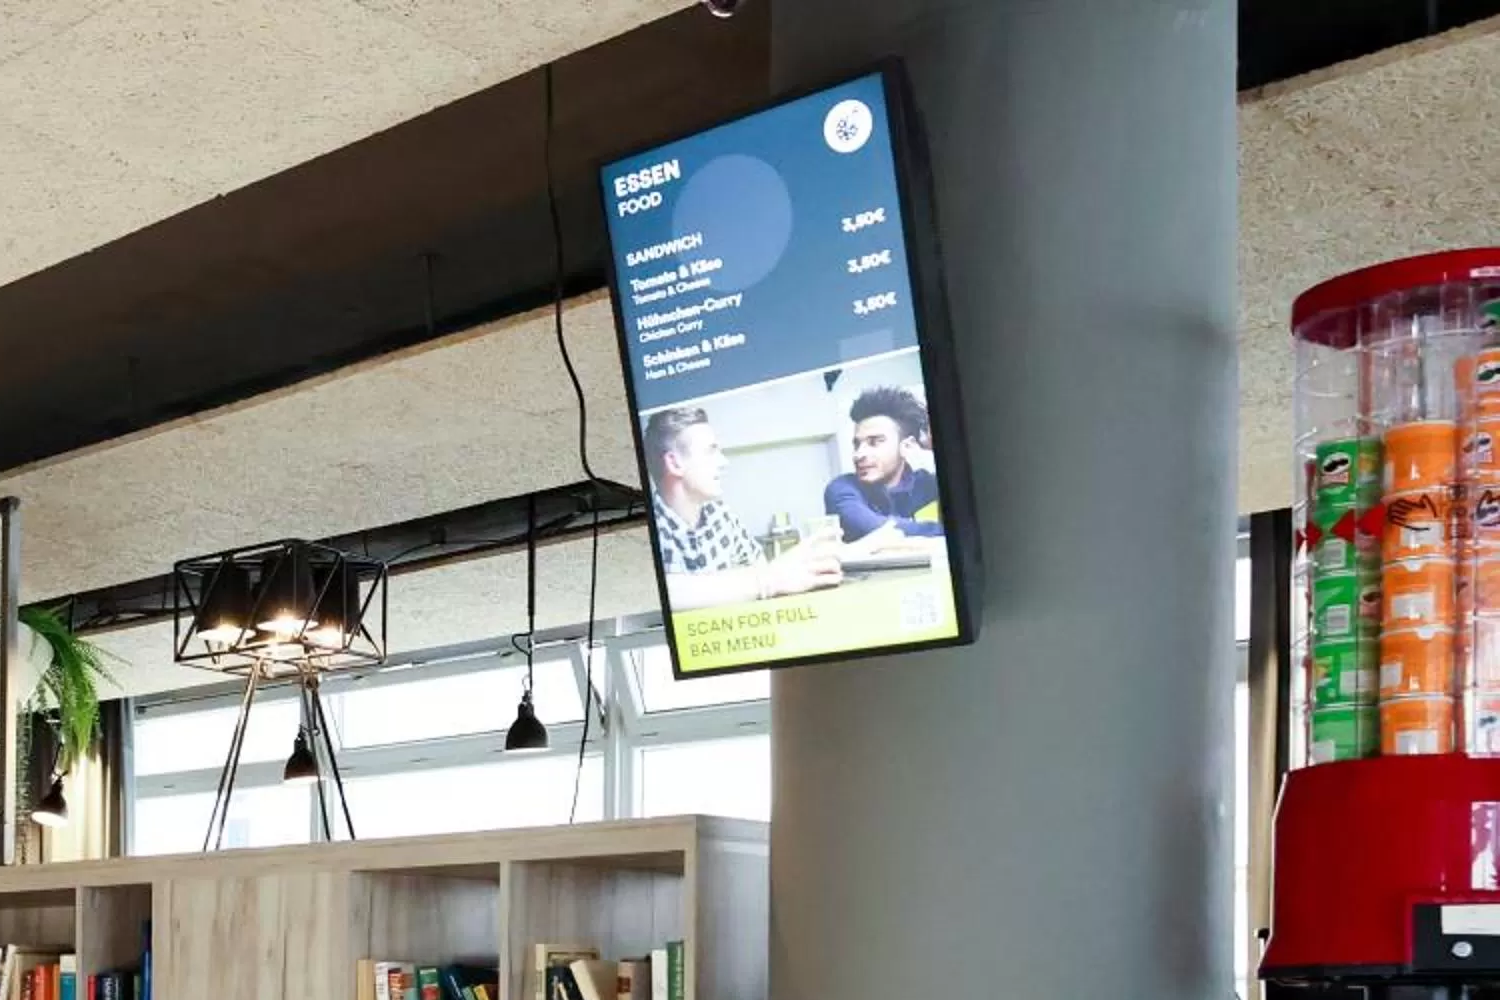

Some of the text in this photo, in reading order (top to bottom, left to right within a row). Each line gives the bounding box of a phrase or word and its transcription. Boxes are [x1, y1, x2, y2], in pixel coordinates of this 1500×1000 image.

[614, 159, 681, 198] ESSEN
[618, 192, 663, 217] FOOD
[626, 232, 703, 267] SANDWICH
[687, 604, 819, 638] SCAN FOR FULL
[691, 633, 777, 658] BAR MENU
